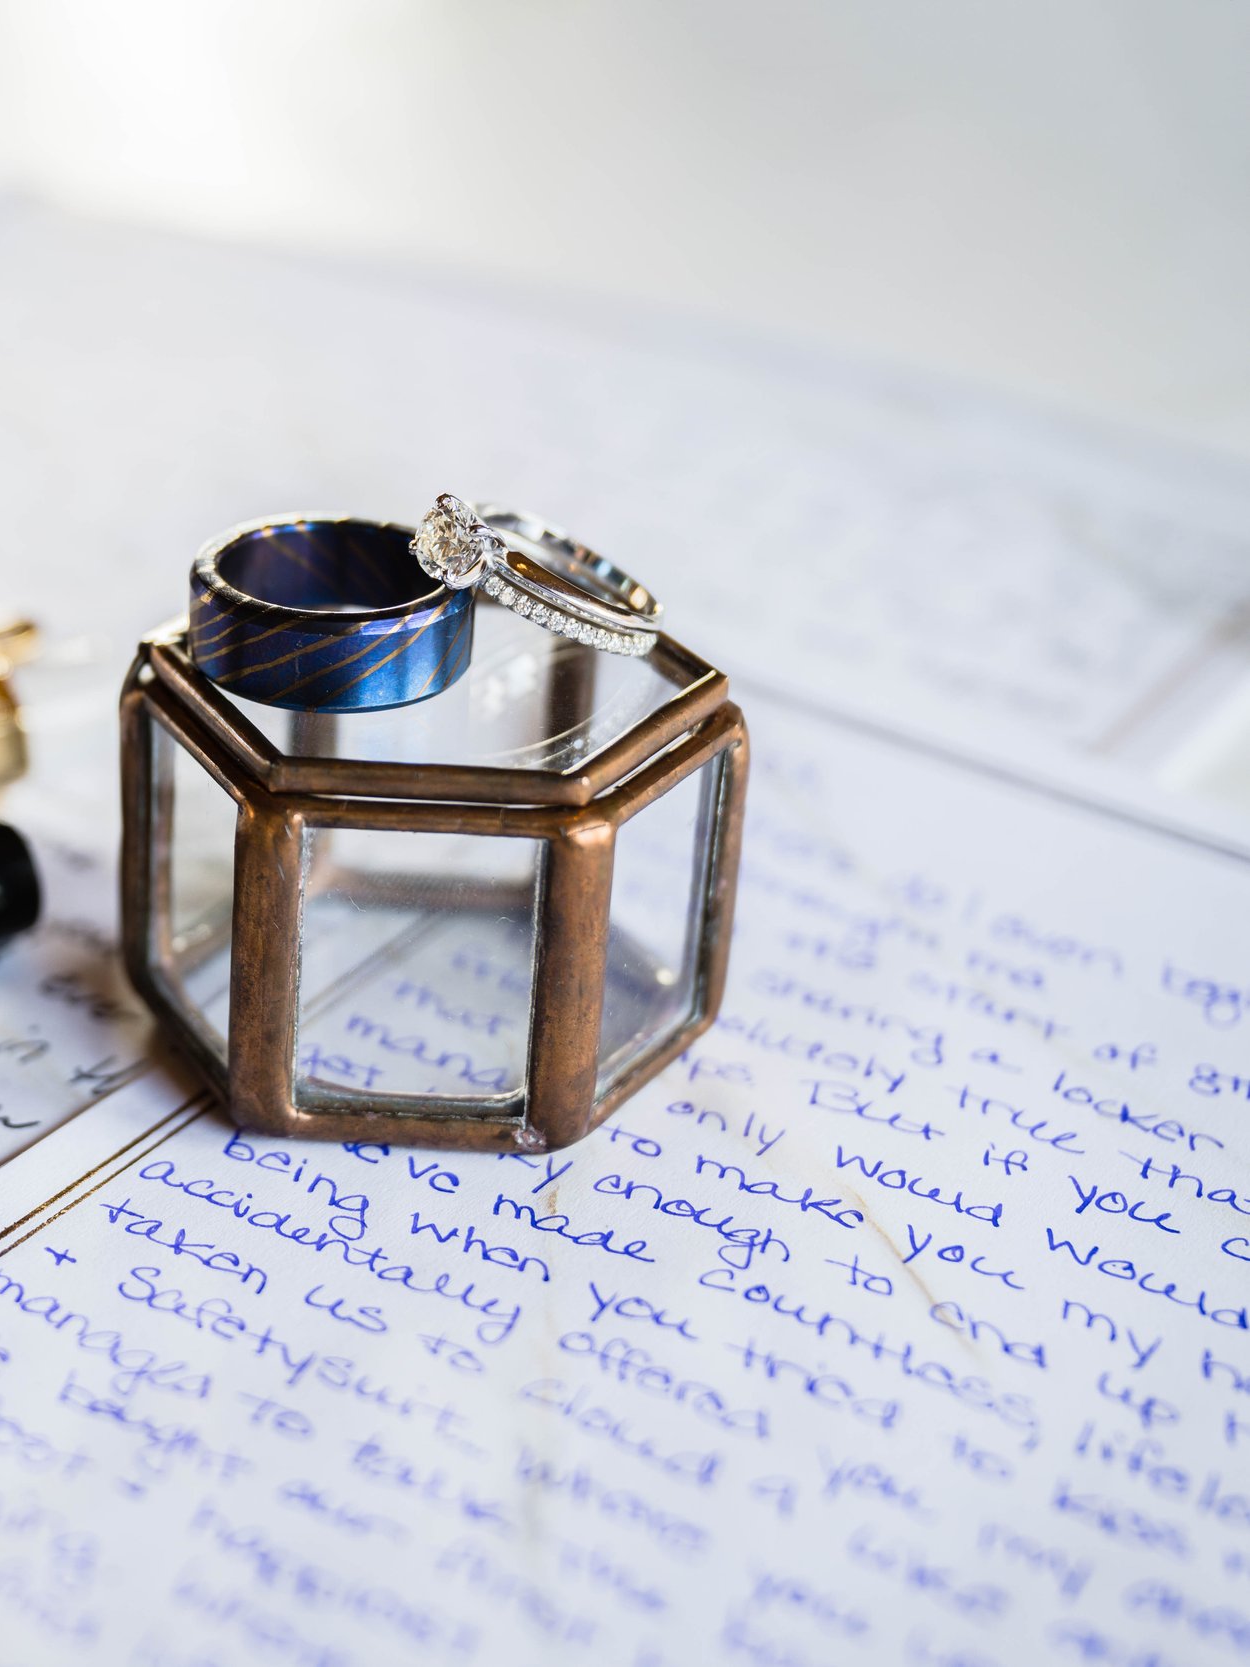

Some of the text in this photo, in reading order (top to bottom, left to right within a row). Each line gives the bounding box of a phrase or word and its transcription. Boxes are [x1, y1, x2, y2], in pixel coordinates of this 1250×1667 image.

[344, 1013, 1163, 1369] mana to make you my
[946, 1085, 1085, 1154] true
[1119, 1149, 1250, 1215] tha
[1052, 1068, 1225, 1151] locker
[100, 1198, 269, 1294] taken
[304, 1283, 389, 1335] us
[418, 1330, 487, 1375] to
[139, 1159, 521, 1345] accidentally
[222, 1130, 371, 1241] being
[410, 1210, 551, 1283] when
[589, 1281, 699, 1341] you
[492, 1193, 656, 1263] made
[594, 1174, 791, 1270] enough
[823, 1254, 894, 1296] to
[930, 1301, 1048, 1369] end
[666, 1100, 786, 1157] only
[836, 1144, 1002, 1227] would
[1046, 1227, 1249, 1330] would
[1068, 1175, 1180, 1234] you
